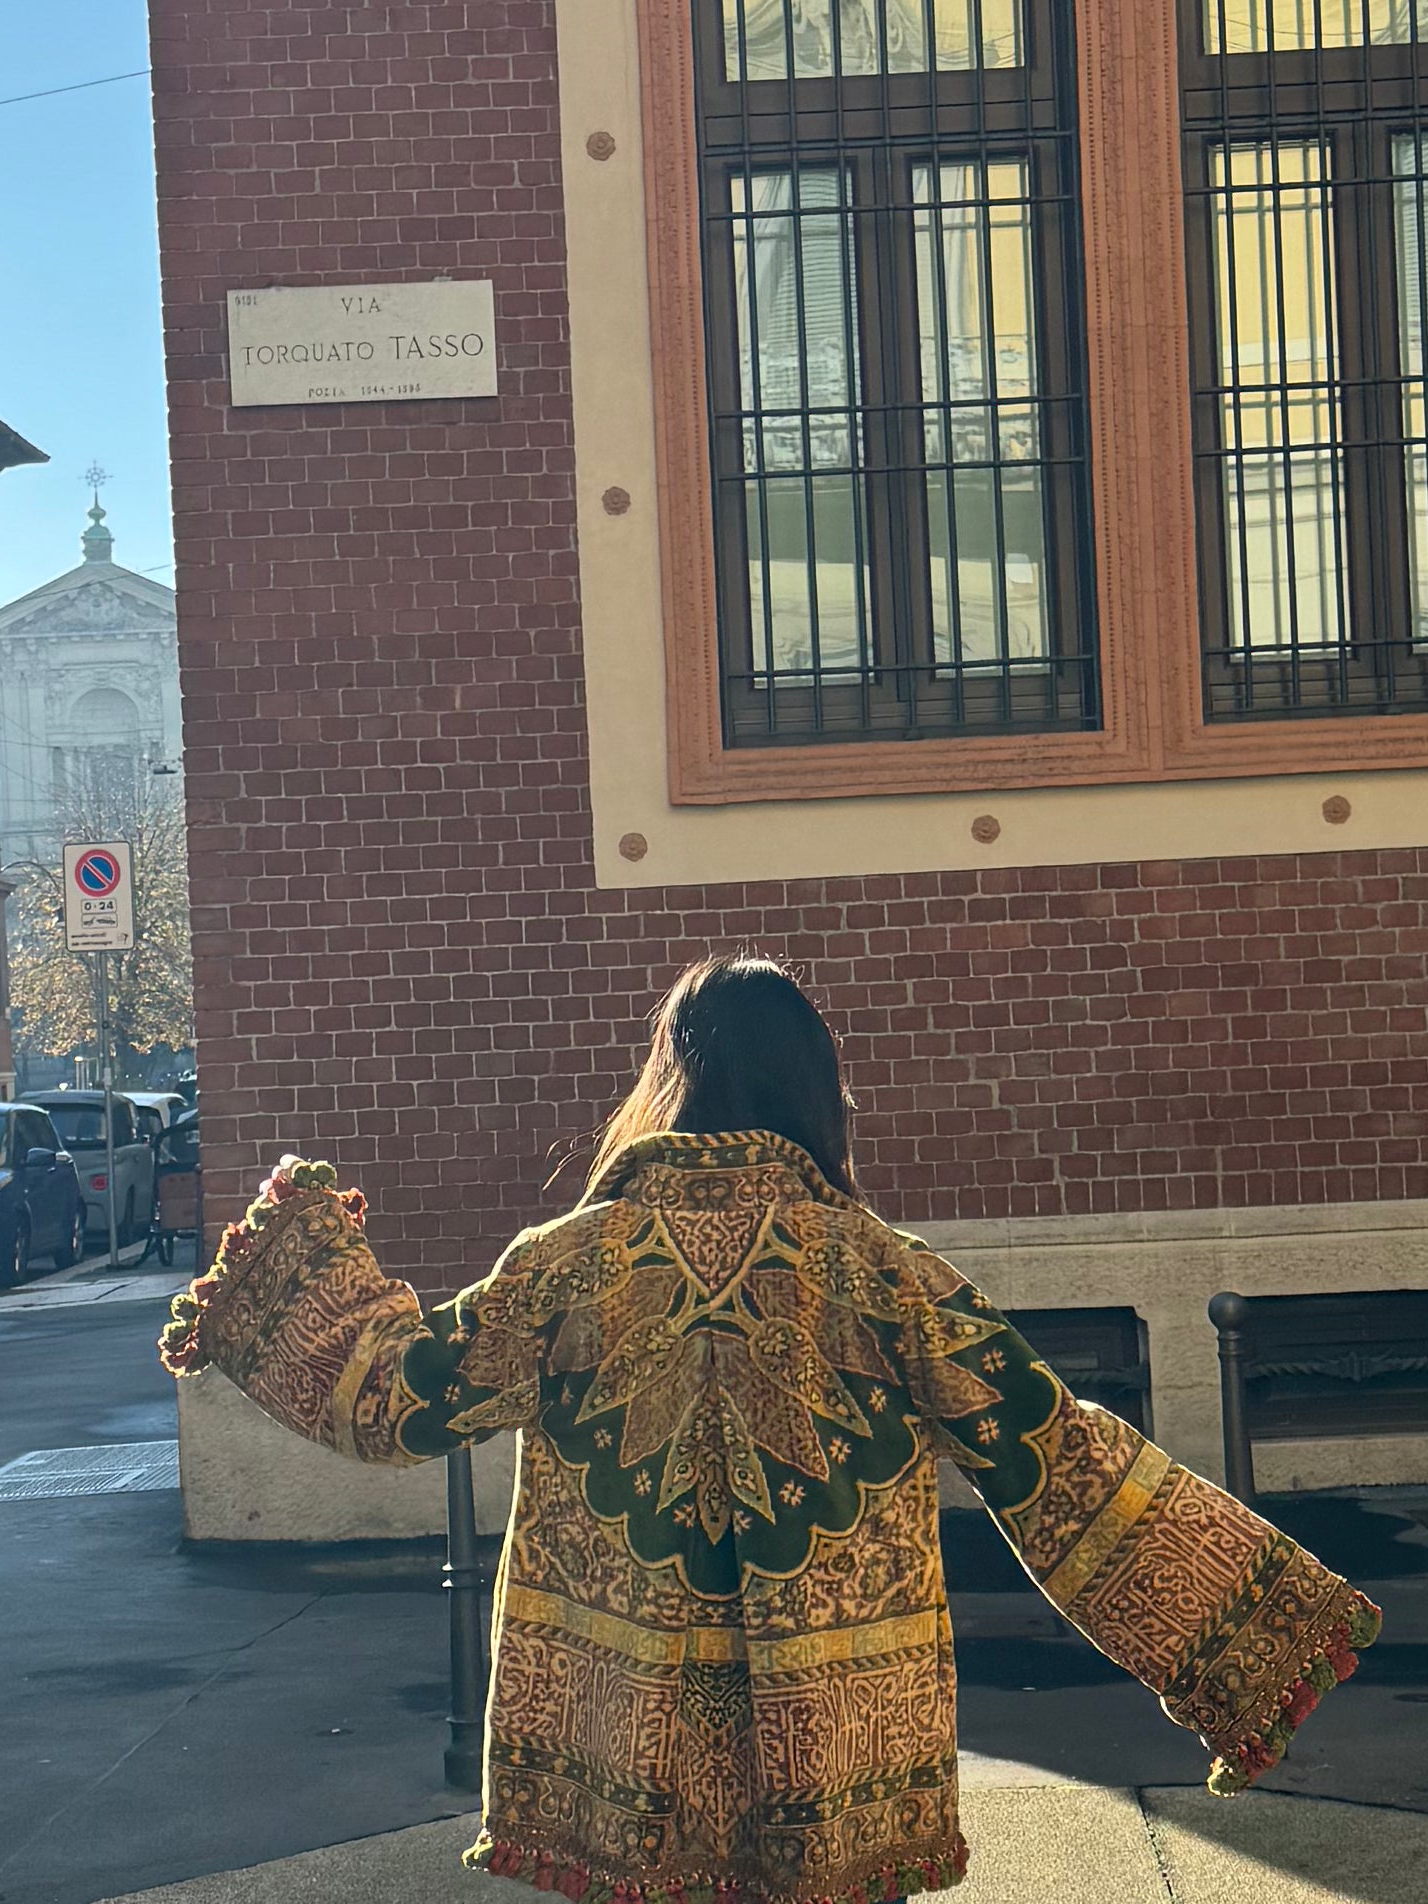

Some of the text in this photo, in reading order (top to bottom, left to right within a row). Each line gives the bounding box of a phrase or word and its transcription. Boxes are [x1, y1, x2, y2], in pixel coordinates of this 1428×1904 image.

[341, 296, 383, 316] VIA
[241, 333, 484, 366] TORQUATO TASSO
